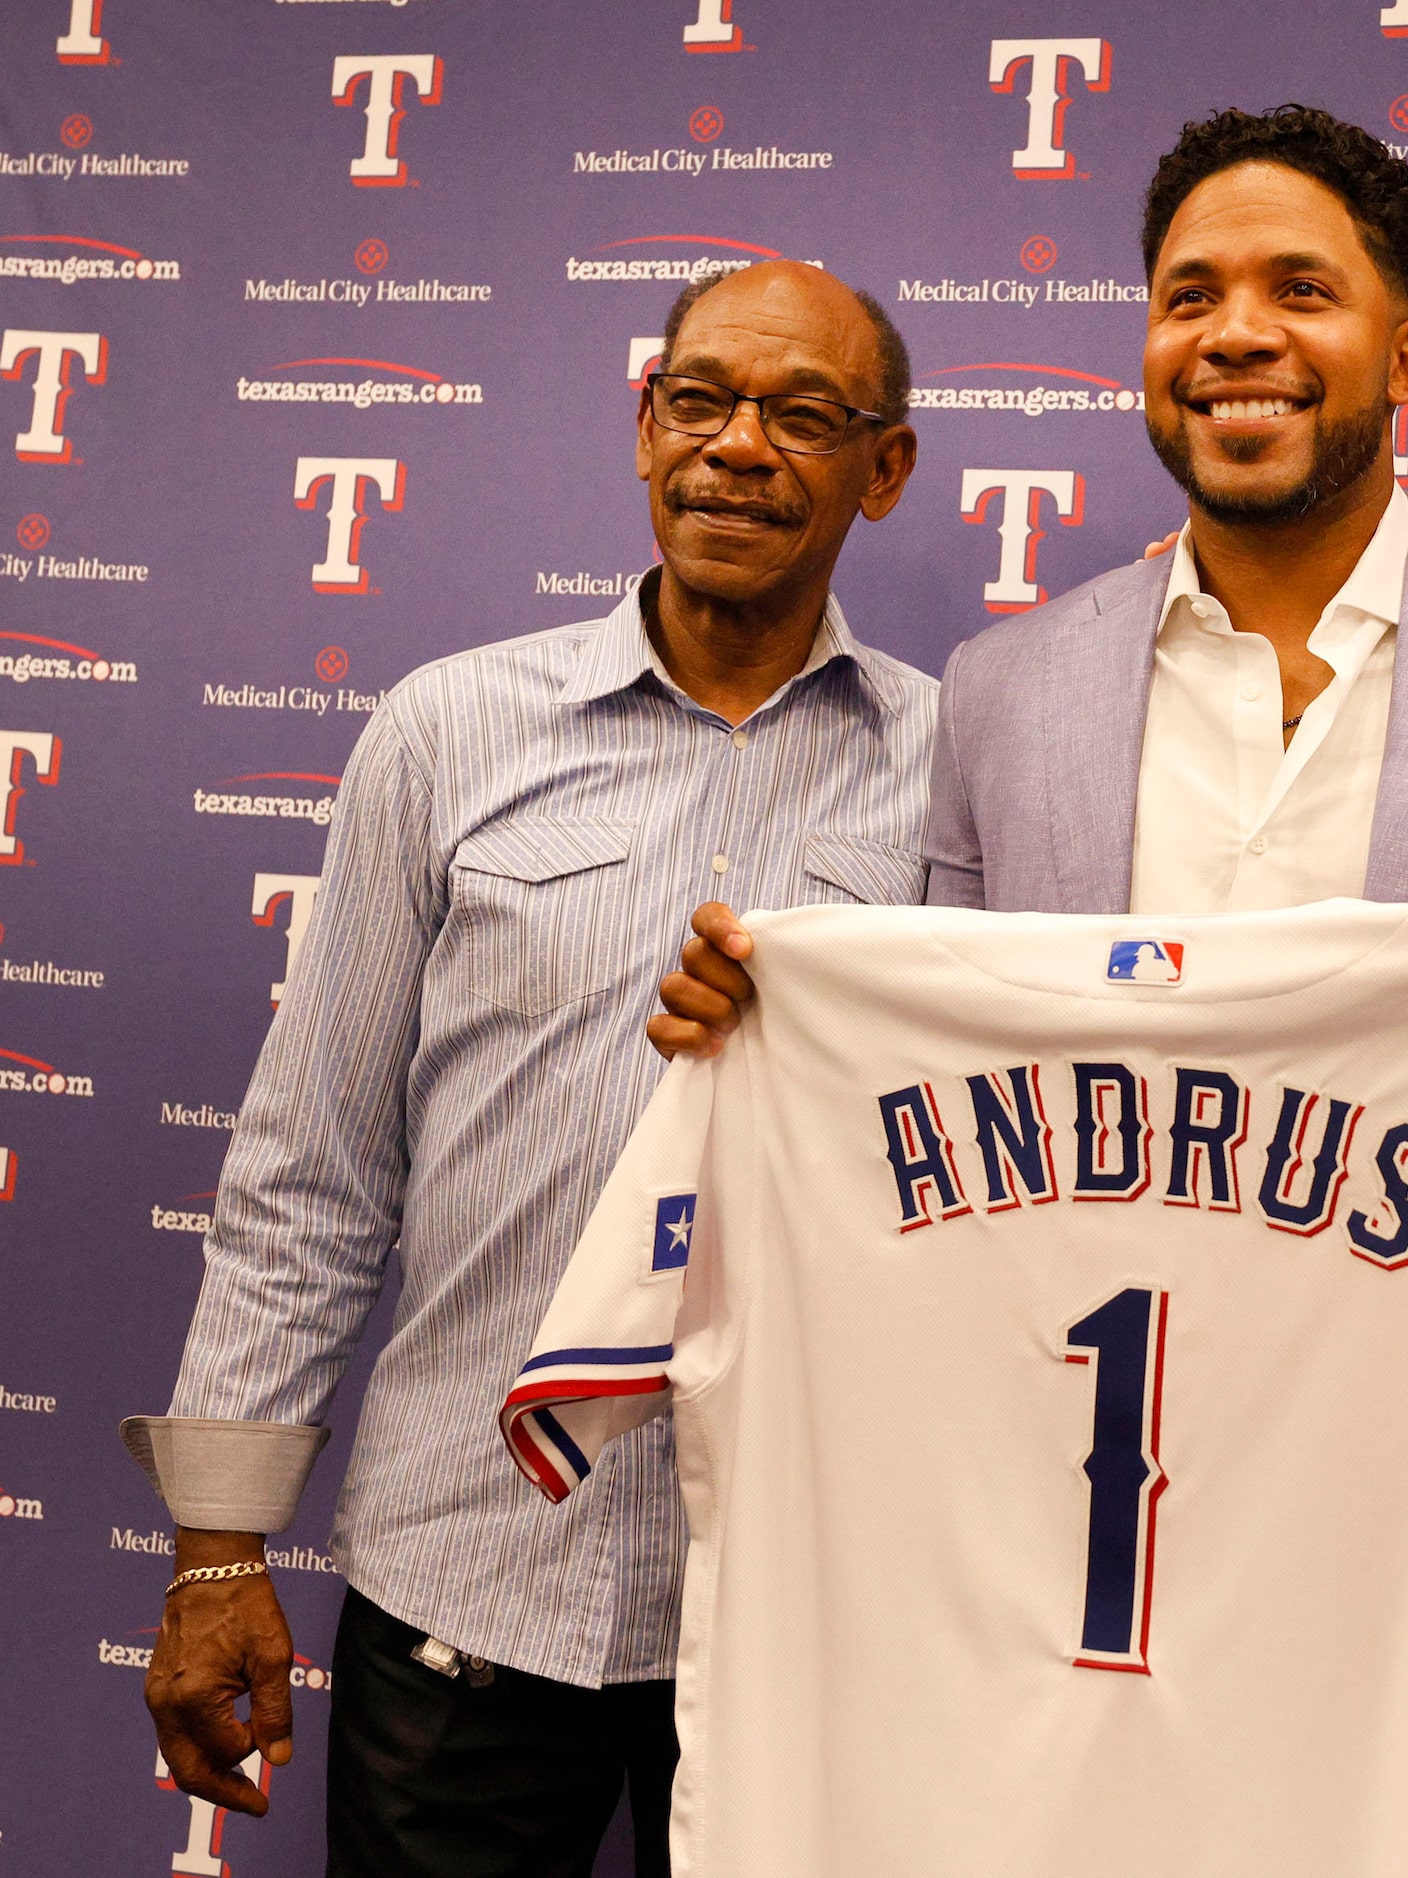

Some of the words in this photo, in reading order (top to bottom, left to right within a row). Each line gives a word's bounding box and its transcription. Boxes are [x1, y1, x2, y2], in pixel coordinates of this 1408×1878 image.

[331, 53, 444, 188] T
[989, 38, 1112, 180] T
[0, 152, 35, 176] ical
[36, 154, 76, 181] City
[80, 153, 189, 176] Healthcare
[573, 150, 659, 173] Medical
[661, 149, 706, 176] City
[711, 147, 833, 170] Healthcare
[244, 279, 326, 301] Medical
[328, 280, 371, 307] City
[376, 279, 492, 301] Healthcare
[897, 280, 988, 302] Medical
[992, 280, 1039, 308] City
[0, 329, 108, 464] T
[236, 377, 483, 408] texasrangers.com
[294, 457, 407, 595] T
[960, 469, 1086, 614] T
[37, 556, 149, 582] Healthcare
[535, 572, 622, 596] Medical
[203, 684, 285, 709] Medical
[288, 688, 331, 716] City
[193, 788, 337, 826] texasrang
[160, 1102, 240, 1130] Medica
[1057, 1283, 1169, 1676] 1
